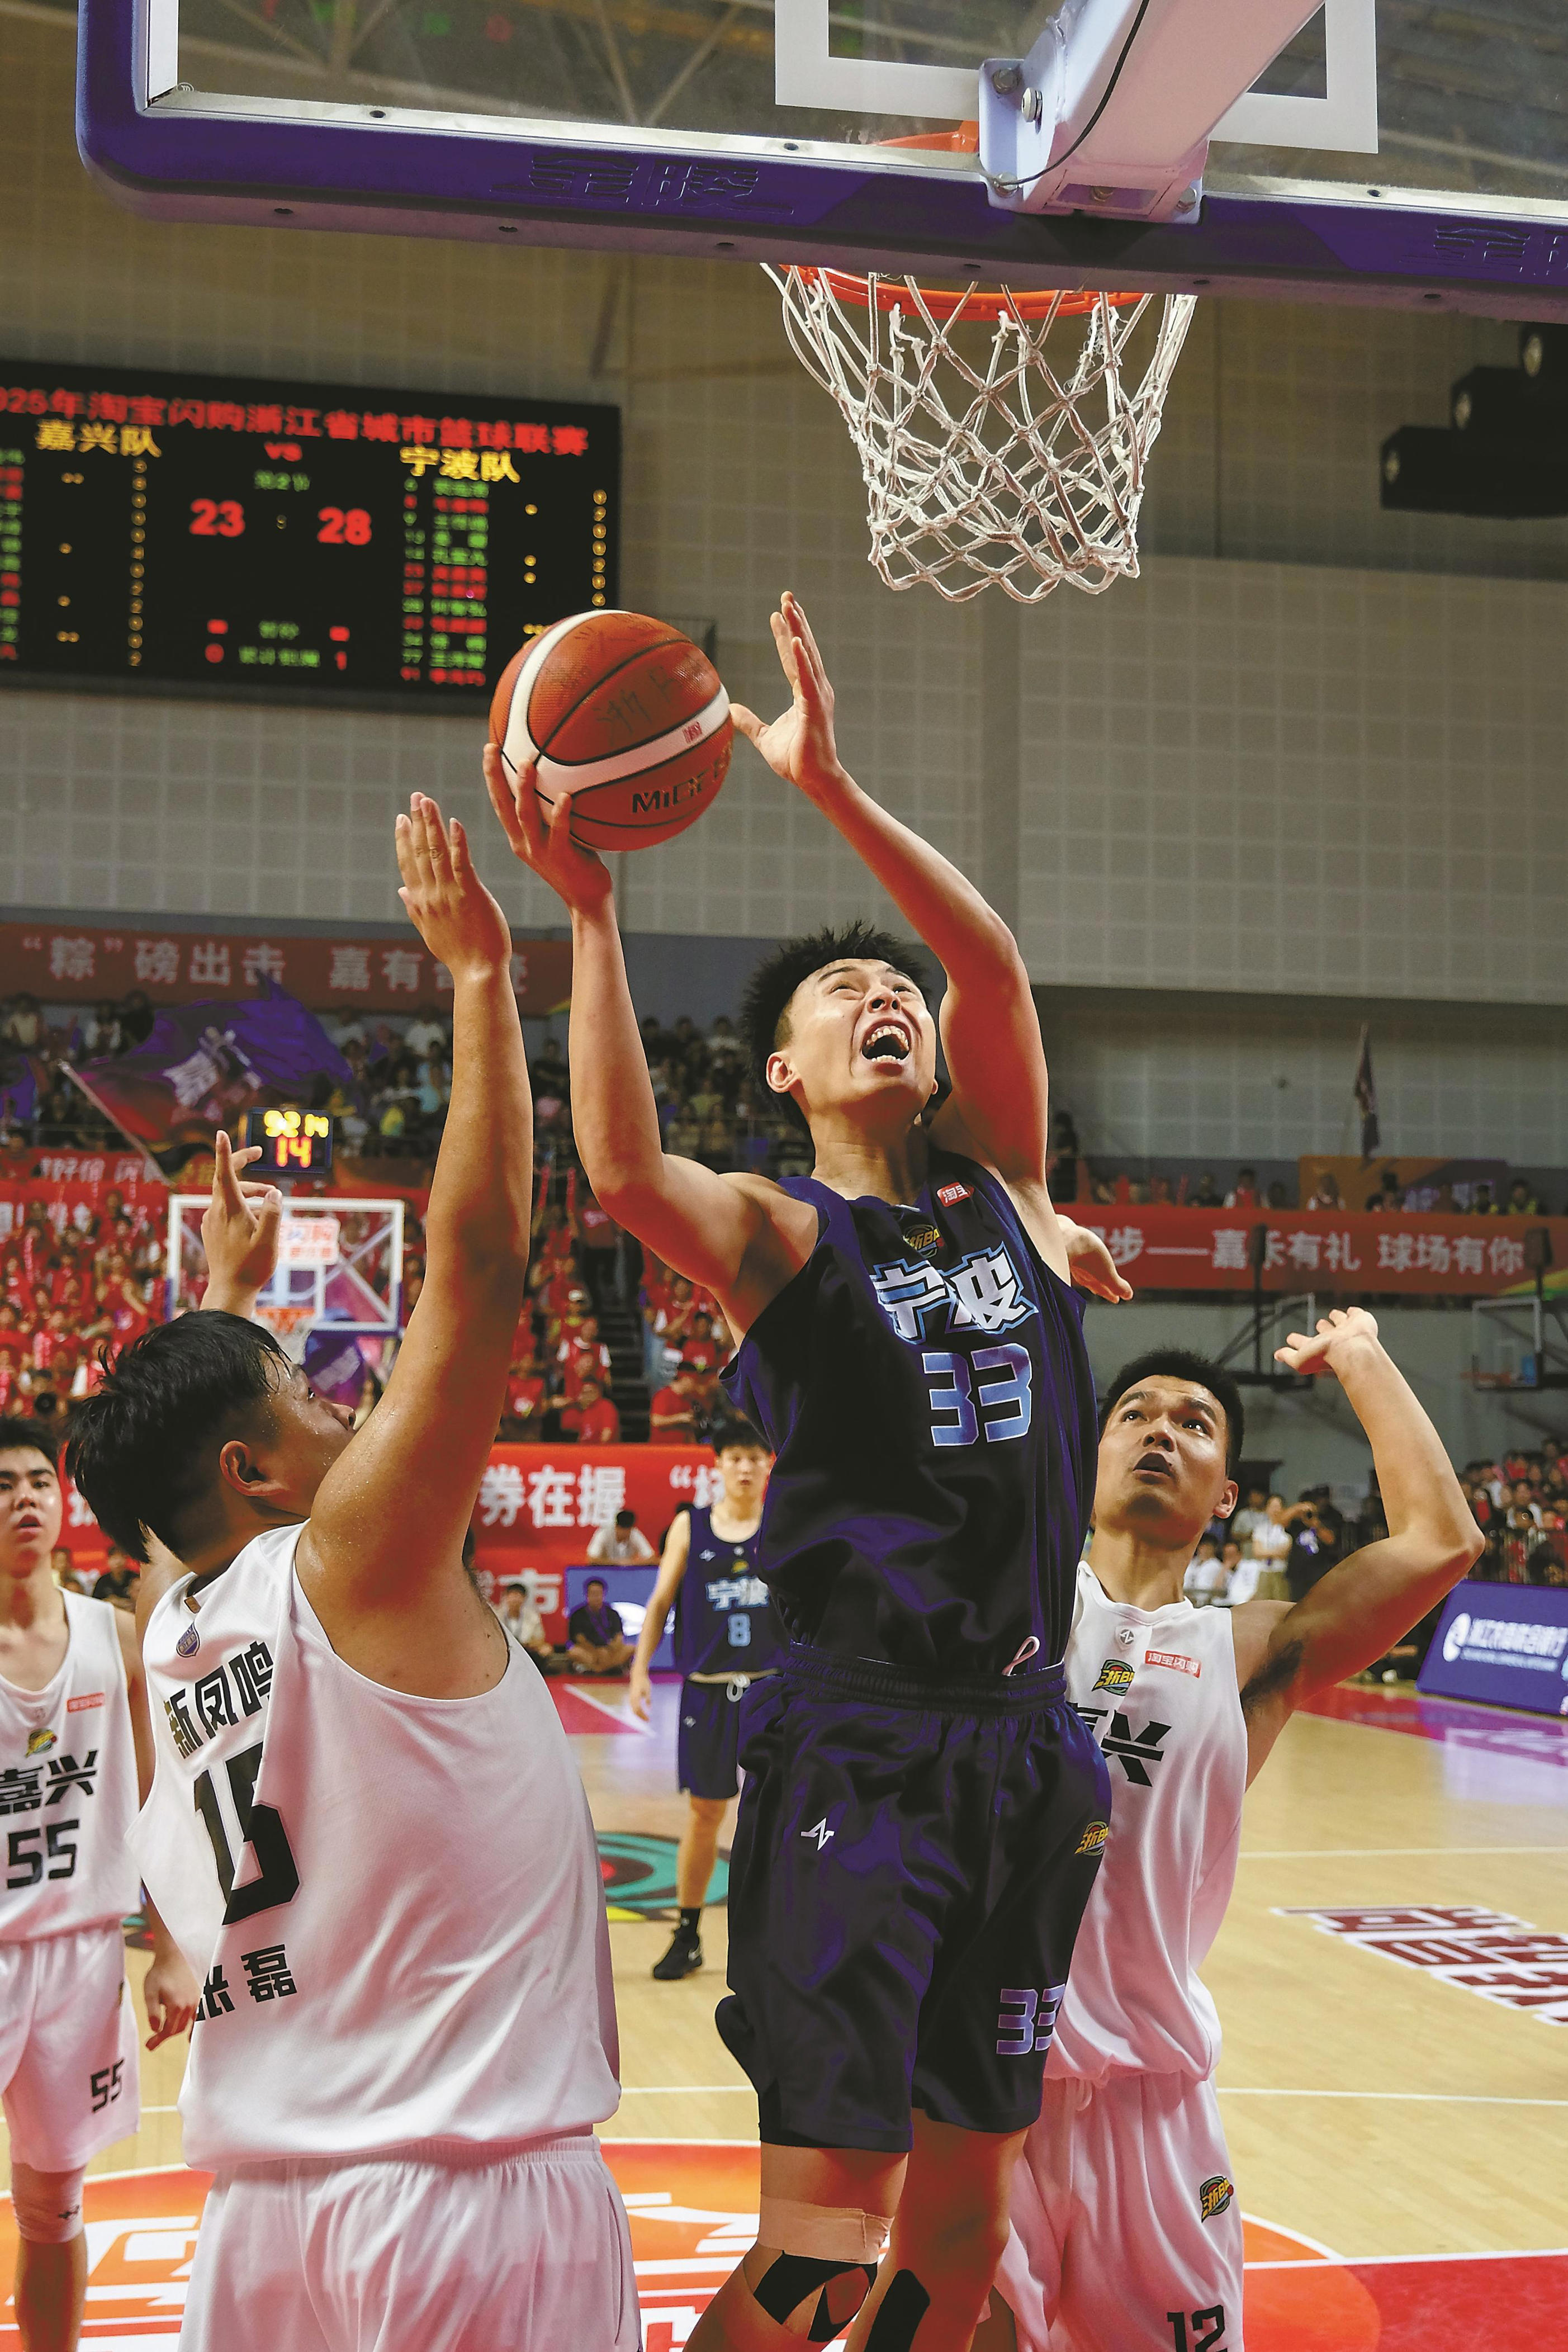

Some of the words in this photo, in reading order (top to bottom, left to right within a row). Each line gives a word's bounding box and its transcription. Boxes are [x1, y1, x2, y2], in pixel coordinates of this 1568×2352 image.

[35, 419, 162, 457] 嘉兴队
[400, 444, 521, 483] 宁波队
[189, 498, 245, 537] 23
[317, 507, 372, 546] 28
[329, 945, 529, 995] 嘉有
[276, 1135, 312, 1168] 14
[1376, 1232, 1525, 1276] 球场有你
[870, 1242, 1038, 1344] 宁波
[921, 1342, 1033, 1447] 33
[705, 1575, 770, 1612] 宁波
[727, 1612, 751, 1648] 8
[1147, 1653, 1199, 1674] 淘宝闪购
[1065, 1701, 1172, 1788] 兴
[0, 1750, 99, 1815] 嘉兴
[7, 1819, 80, 1890] 55
[996, 1983, 1065, 2055] 33
[90, 2057, 125, 2114] 55
[1167, 2304, 1228, 2352] 12
